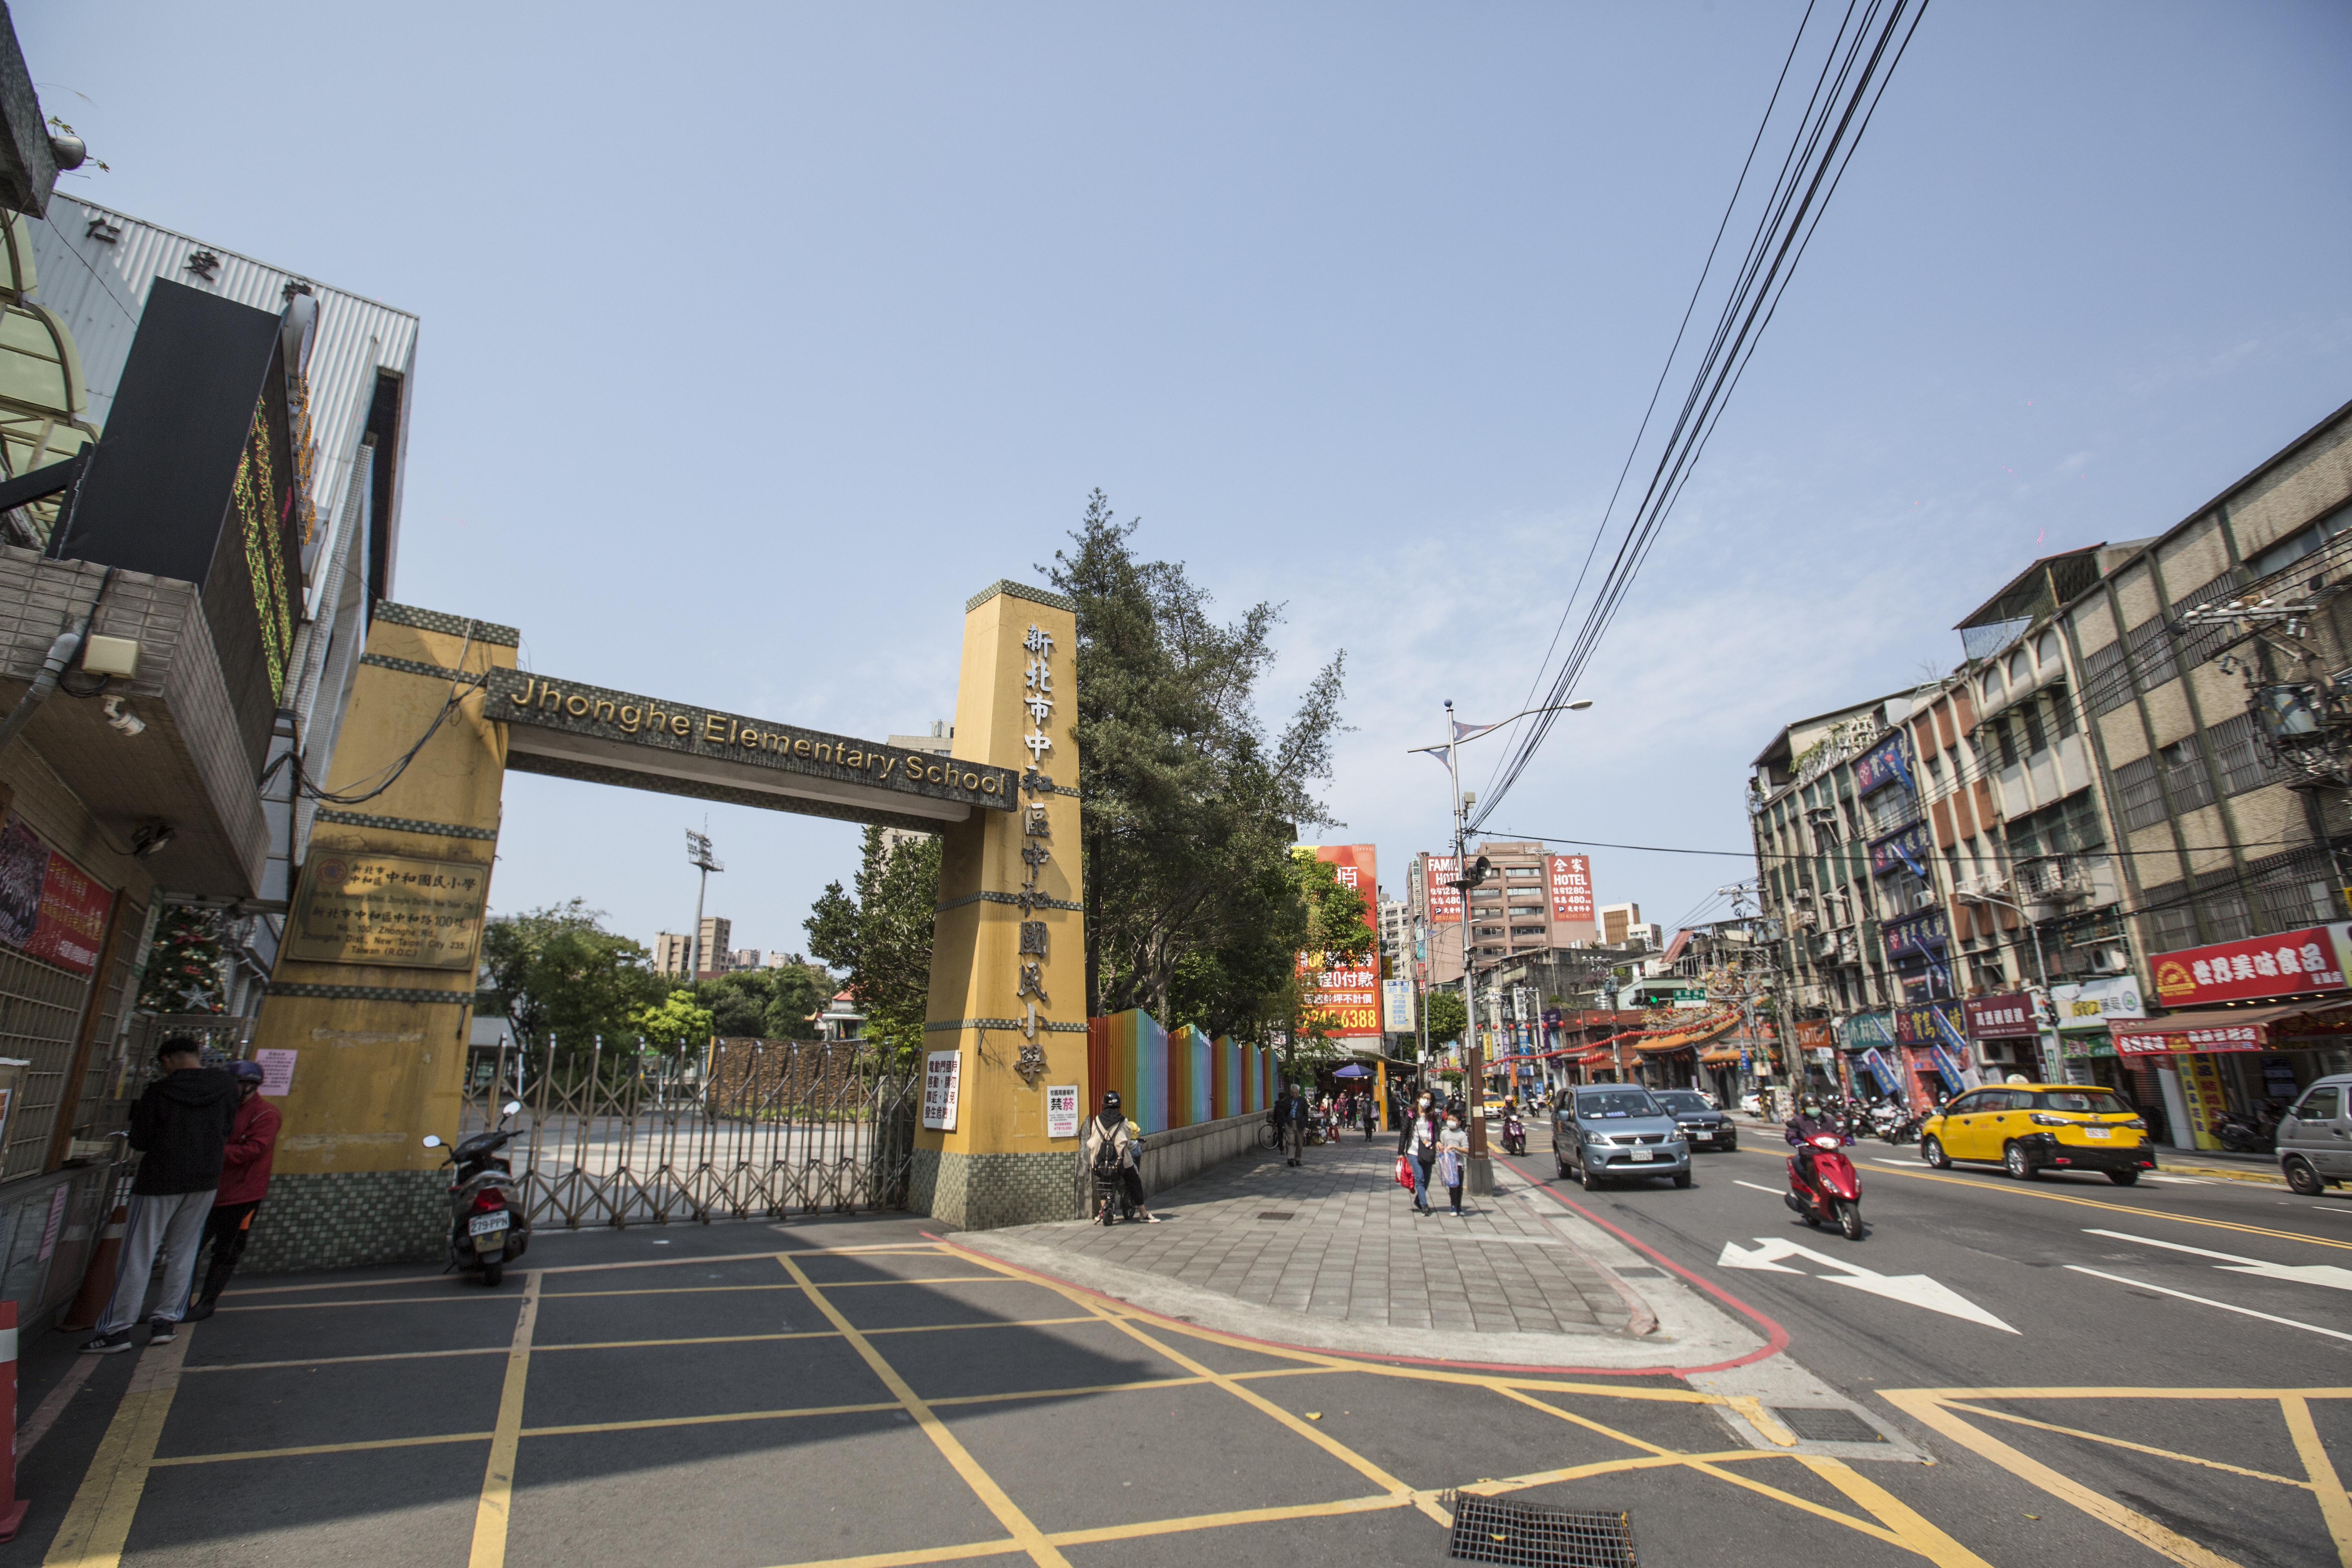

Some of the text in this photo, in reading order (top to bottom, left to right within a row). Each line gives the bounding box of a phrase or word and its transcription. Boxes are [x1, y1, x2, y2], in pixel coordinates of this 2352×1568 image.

[510, 678, 1005, 796] Jhonghe Elementary School
[1014, 623, 1054, 1082] 新北市中和區中和國民小學
[1553, 858, 1585, 873] 全家
[386, 871, 477, 891] 中和國民小學
[1553, 874, 1588, 885] HOTEL
[379, 926, 416, 937] Zhonghe
[352, 945, 380, 955] Taiwan
[374, 936, 392, 945] New
[399, 938, 423, 948] Taipei
[428, 940, 445, 950] City
[2191, 942, 2327, 985] 世界美味食品
[929, 1060, 957, 1073] 電動門隨時
[1051, 1097, 1074, 1111] 禁菸
[470, 1217, 508, 1232] 279-PPN
